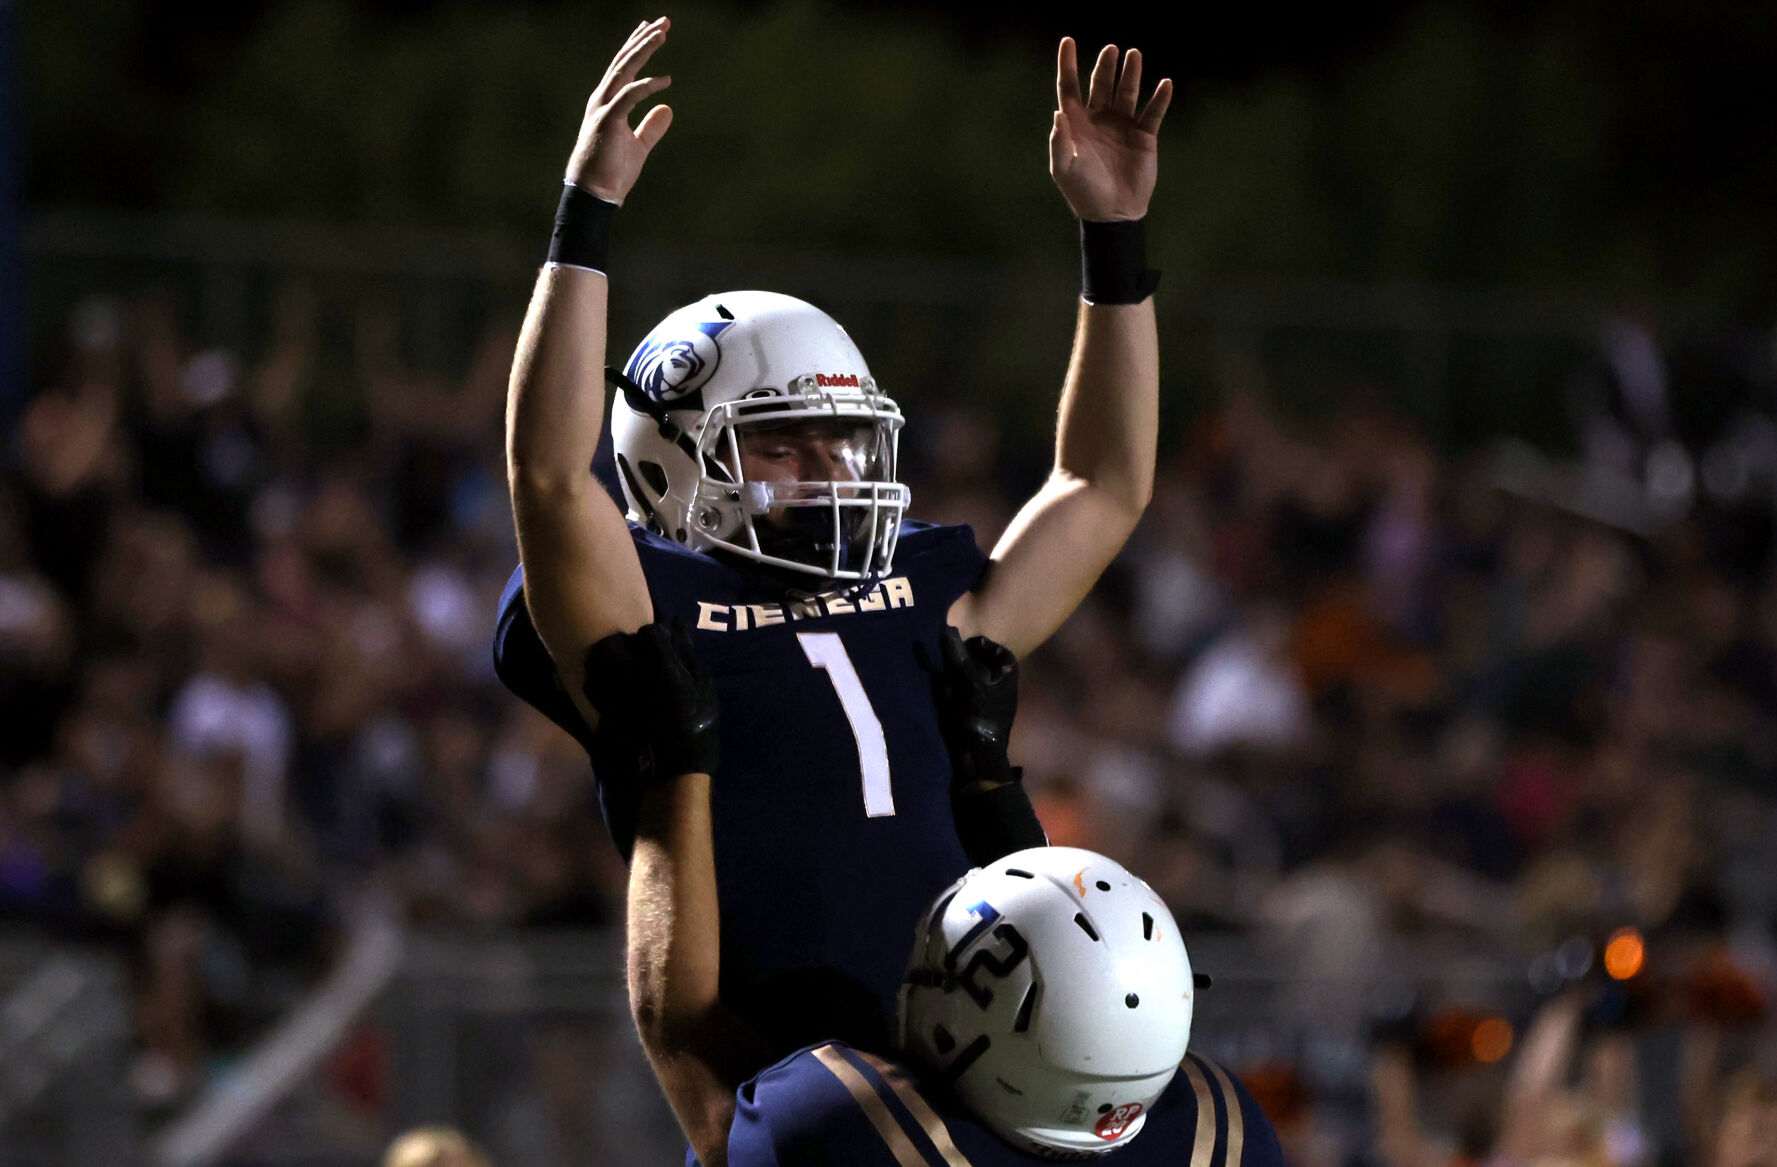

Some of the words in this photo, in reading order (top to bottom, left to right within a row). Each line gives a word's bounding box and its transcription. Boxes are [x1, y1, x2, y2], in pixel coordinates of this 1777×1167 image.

[816, 373, 859, 387] Riddell
[796, 632, 896, 817] 1
[1109, 1104, 1141, 1121] RP
